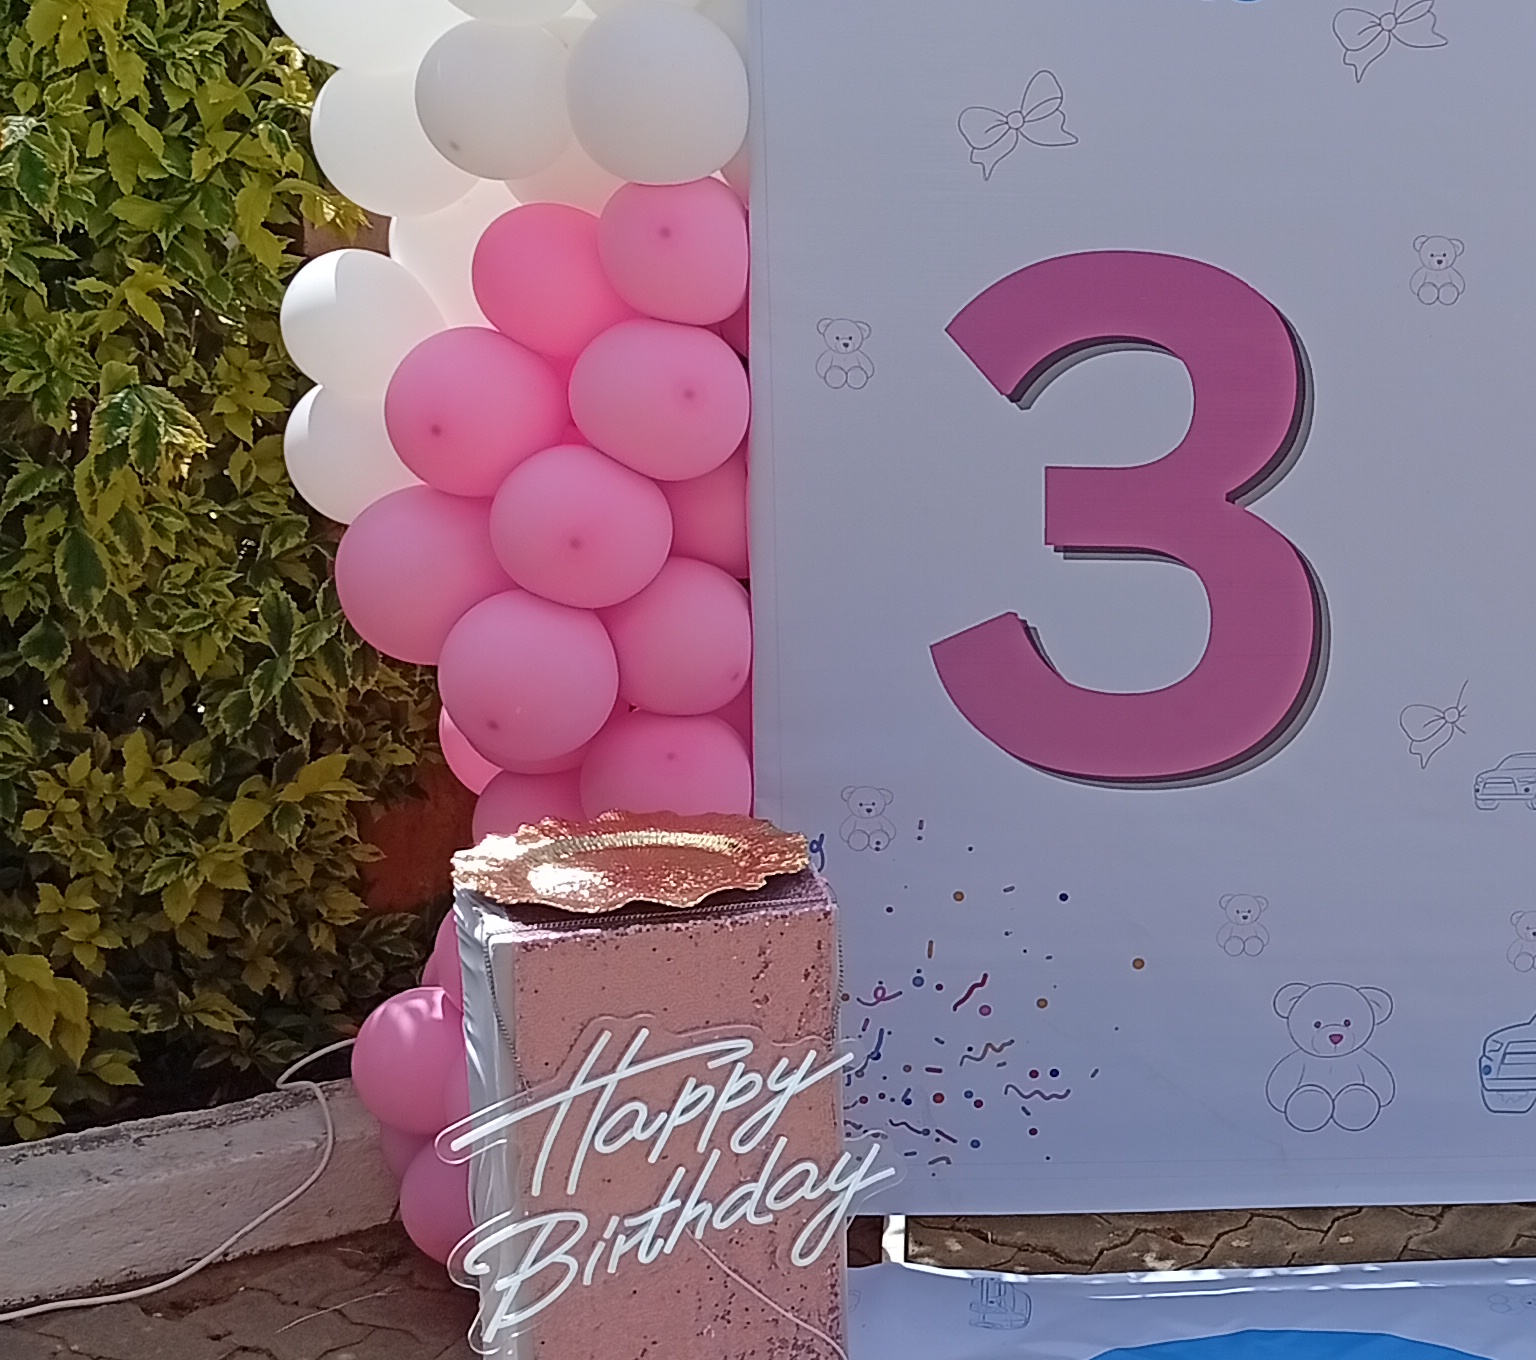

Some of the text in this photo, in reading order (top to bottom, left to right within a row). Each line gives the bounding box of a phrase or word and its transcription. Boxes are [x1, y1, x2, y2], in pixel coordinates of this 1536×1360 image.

[930, 251, 1331, 790] 3
[451, 1028, 855, 1196] Happy
[463, 1137, 895, 1342] Birthday
